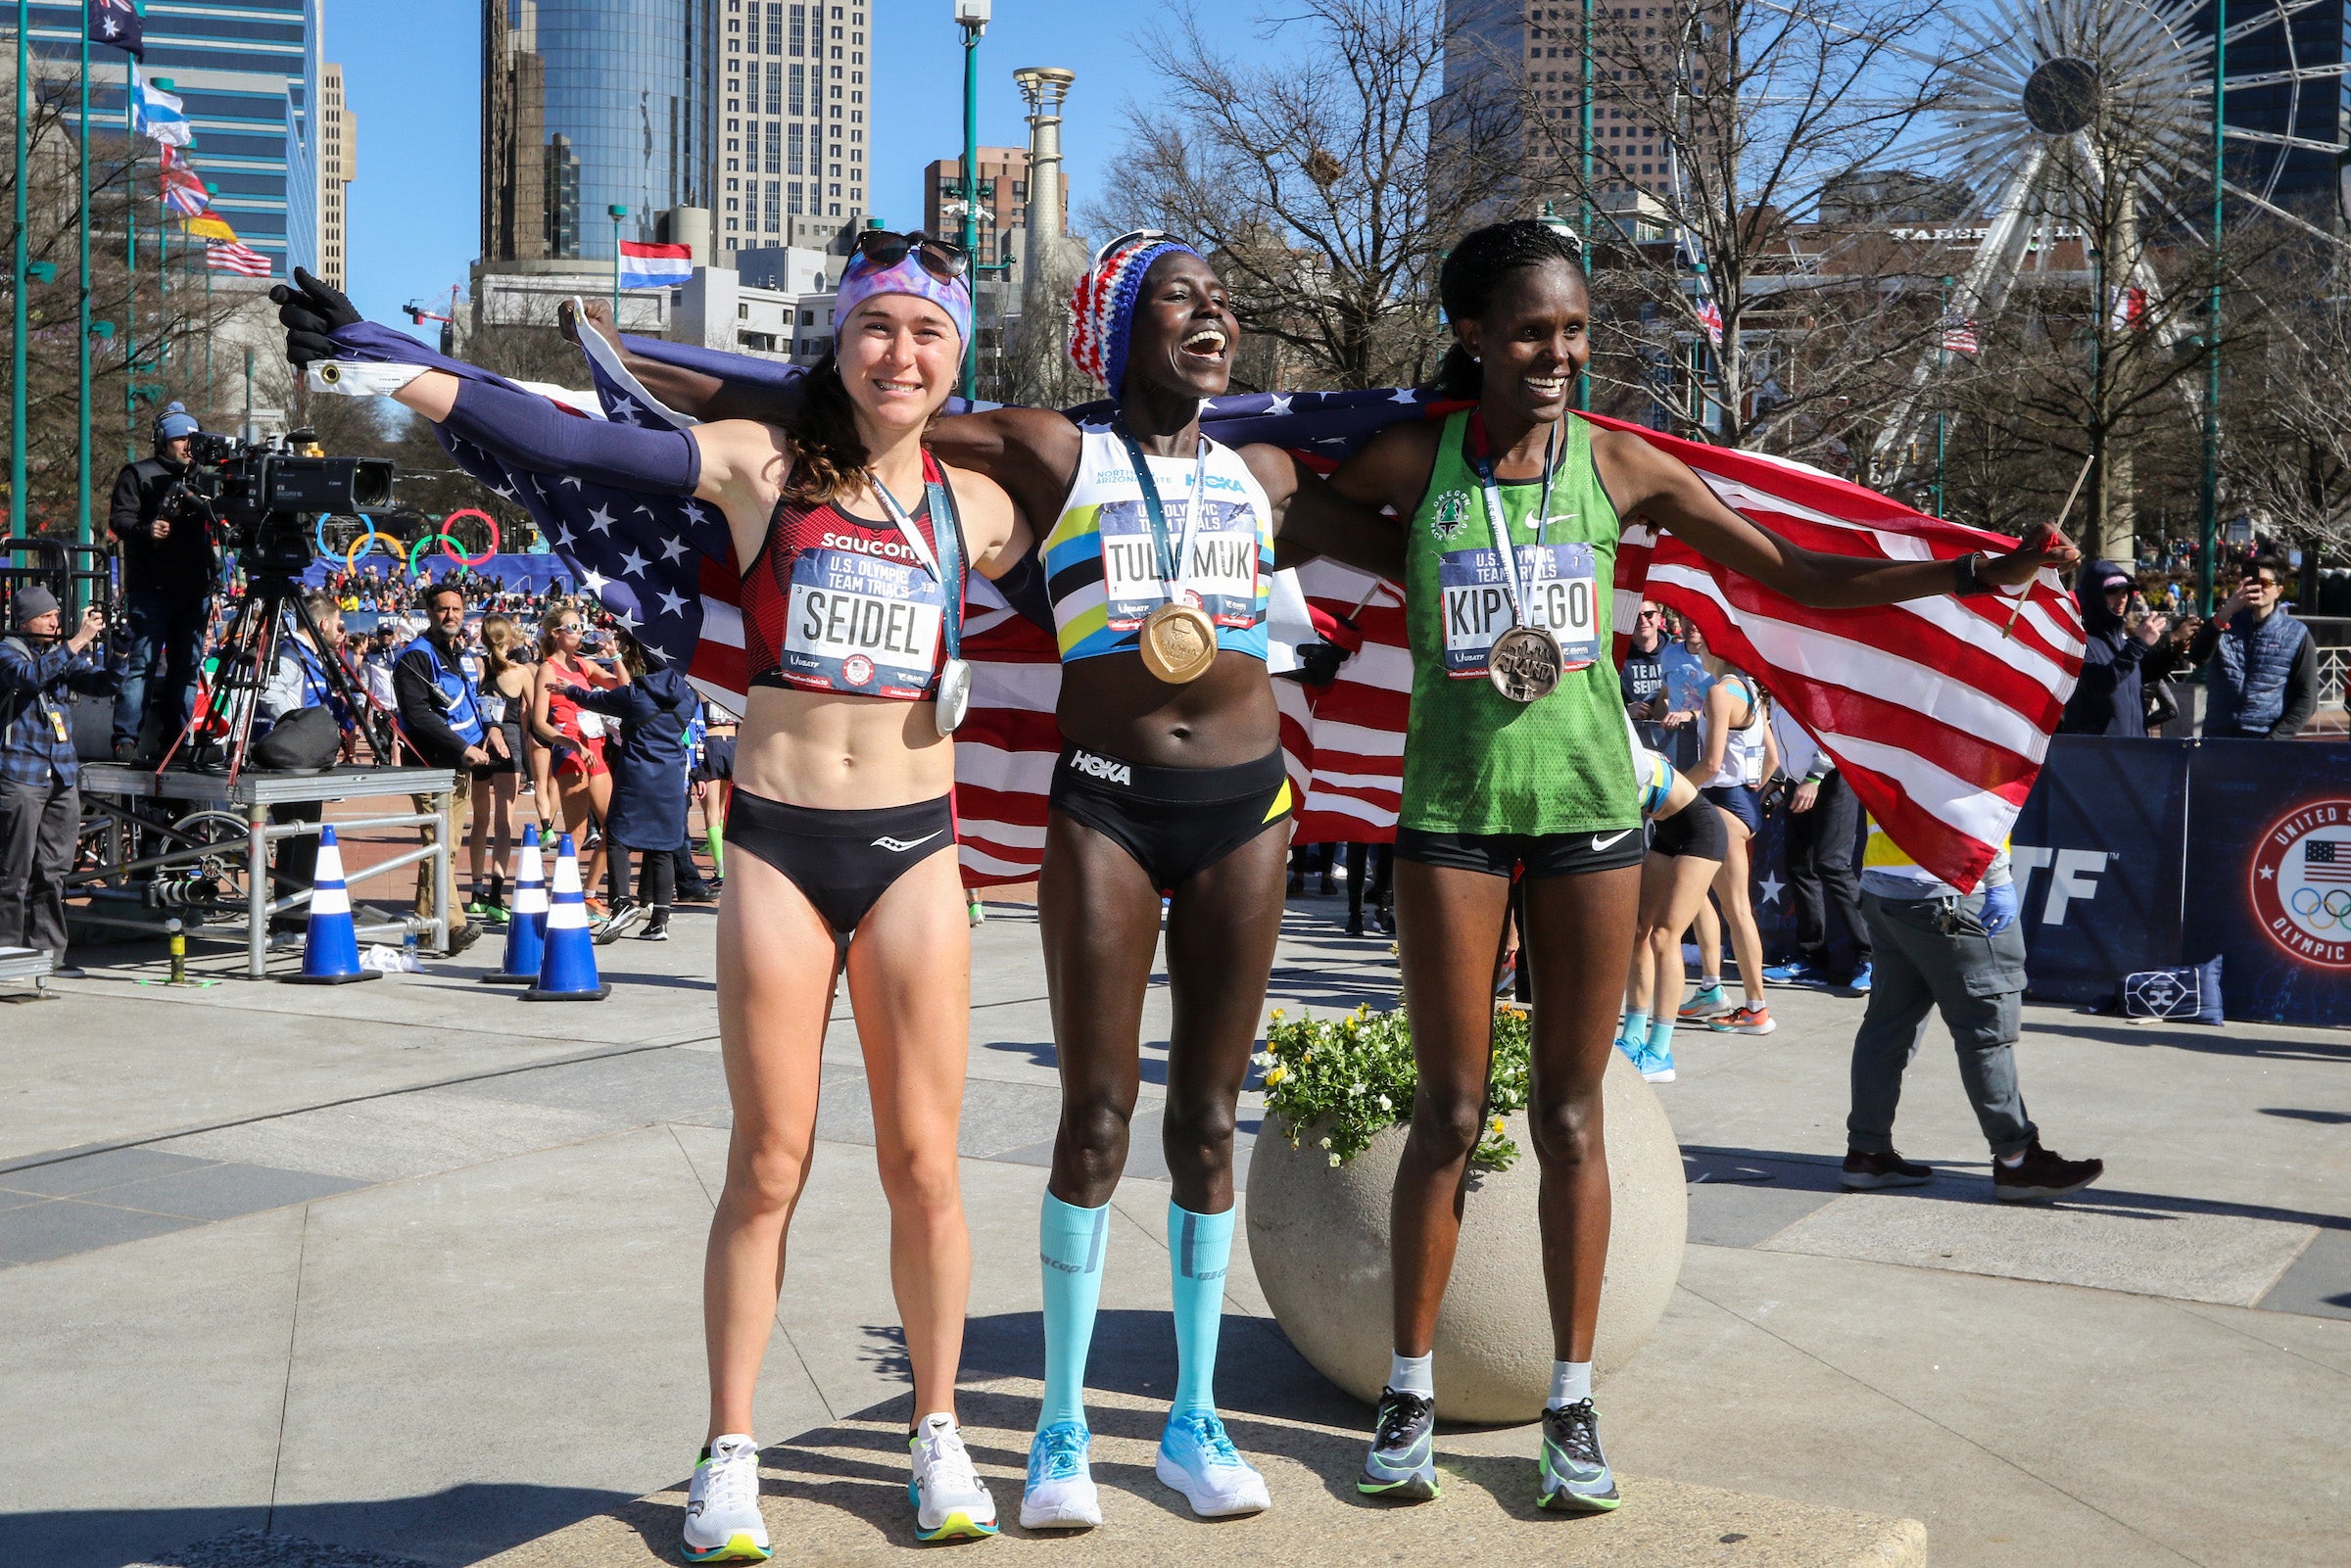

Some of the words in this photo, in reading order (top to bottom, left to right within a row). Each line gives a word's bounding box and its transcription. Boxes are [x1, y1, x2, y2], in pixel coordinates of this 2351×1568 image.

[1889, 226, 2084, 241] TABERCL
[1164, 503, 1219, 517] OLYIC
[1433, 490, 1471, 507] OREGON
[1175, 517, 1222, 532] TALS
[1431, 515, 1444, 542] TRACK
[1451, 514, 1470, 541] CLUB
[821, 532, 922, 565] saucon
[1108, 541, 1251, 582] TULMUK
[1476, 552, 1501, 568] U.S.
[831, 556, 855, 575] U.S.
[857, 560, 910, 586] OLYMPIC
[796, 587, 803, 595] 3
[829, 573, 864, 593] TEAM
[867, 578, 910, 599] TRIALS
[803, 592, 921, 655] SEIDEL
[1070, 749, 1131, 786] HOKA
[2274, 806, 2338, 846] UNITED
[2272, 917, 2345, 962] OLYMPIC
